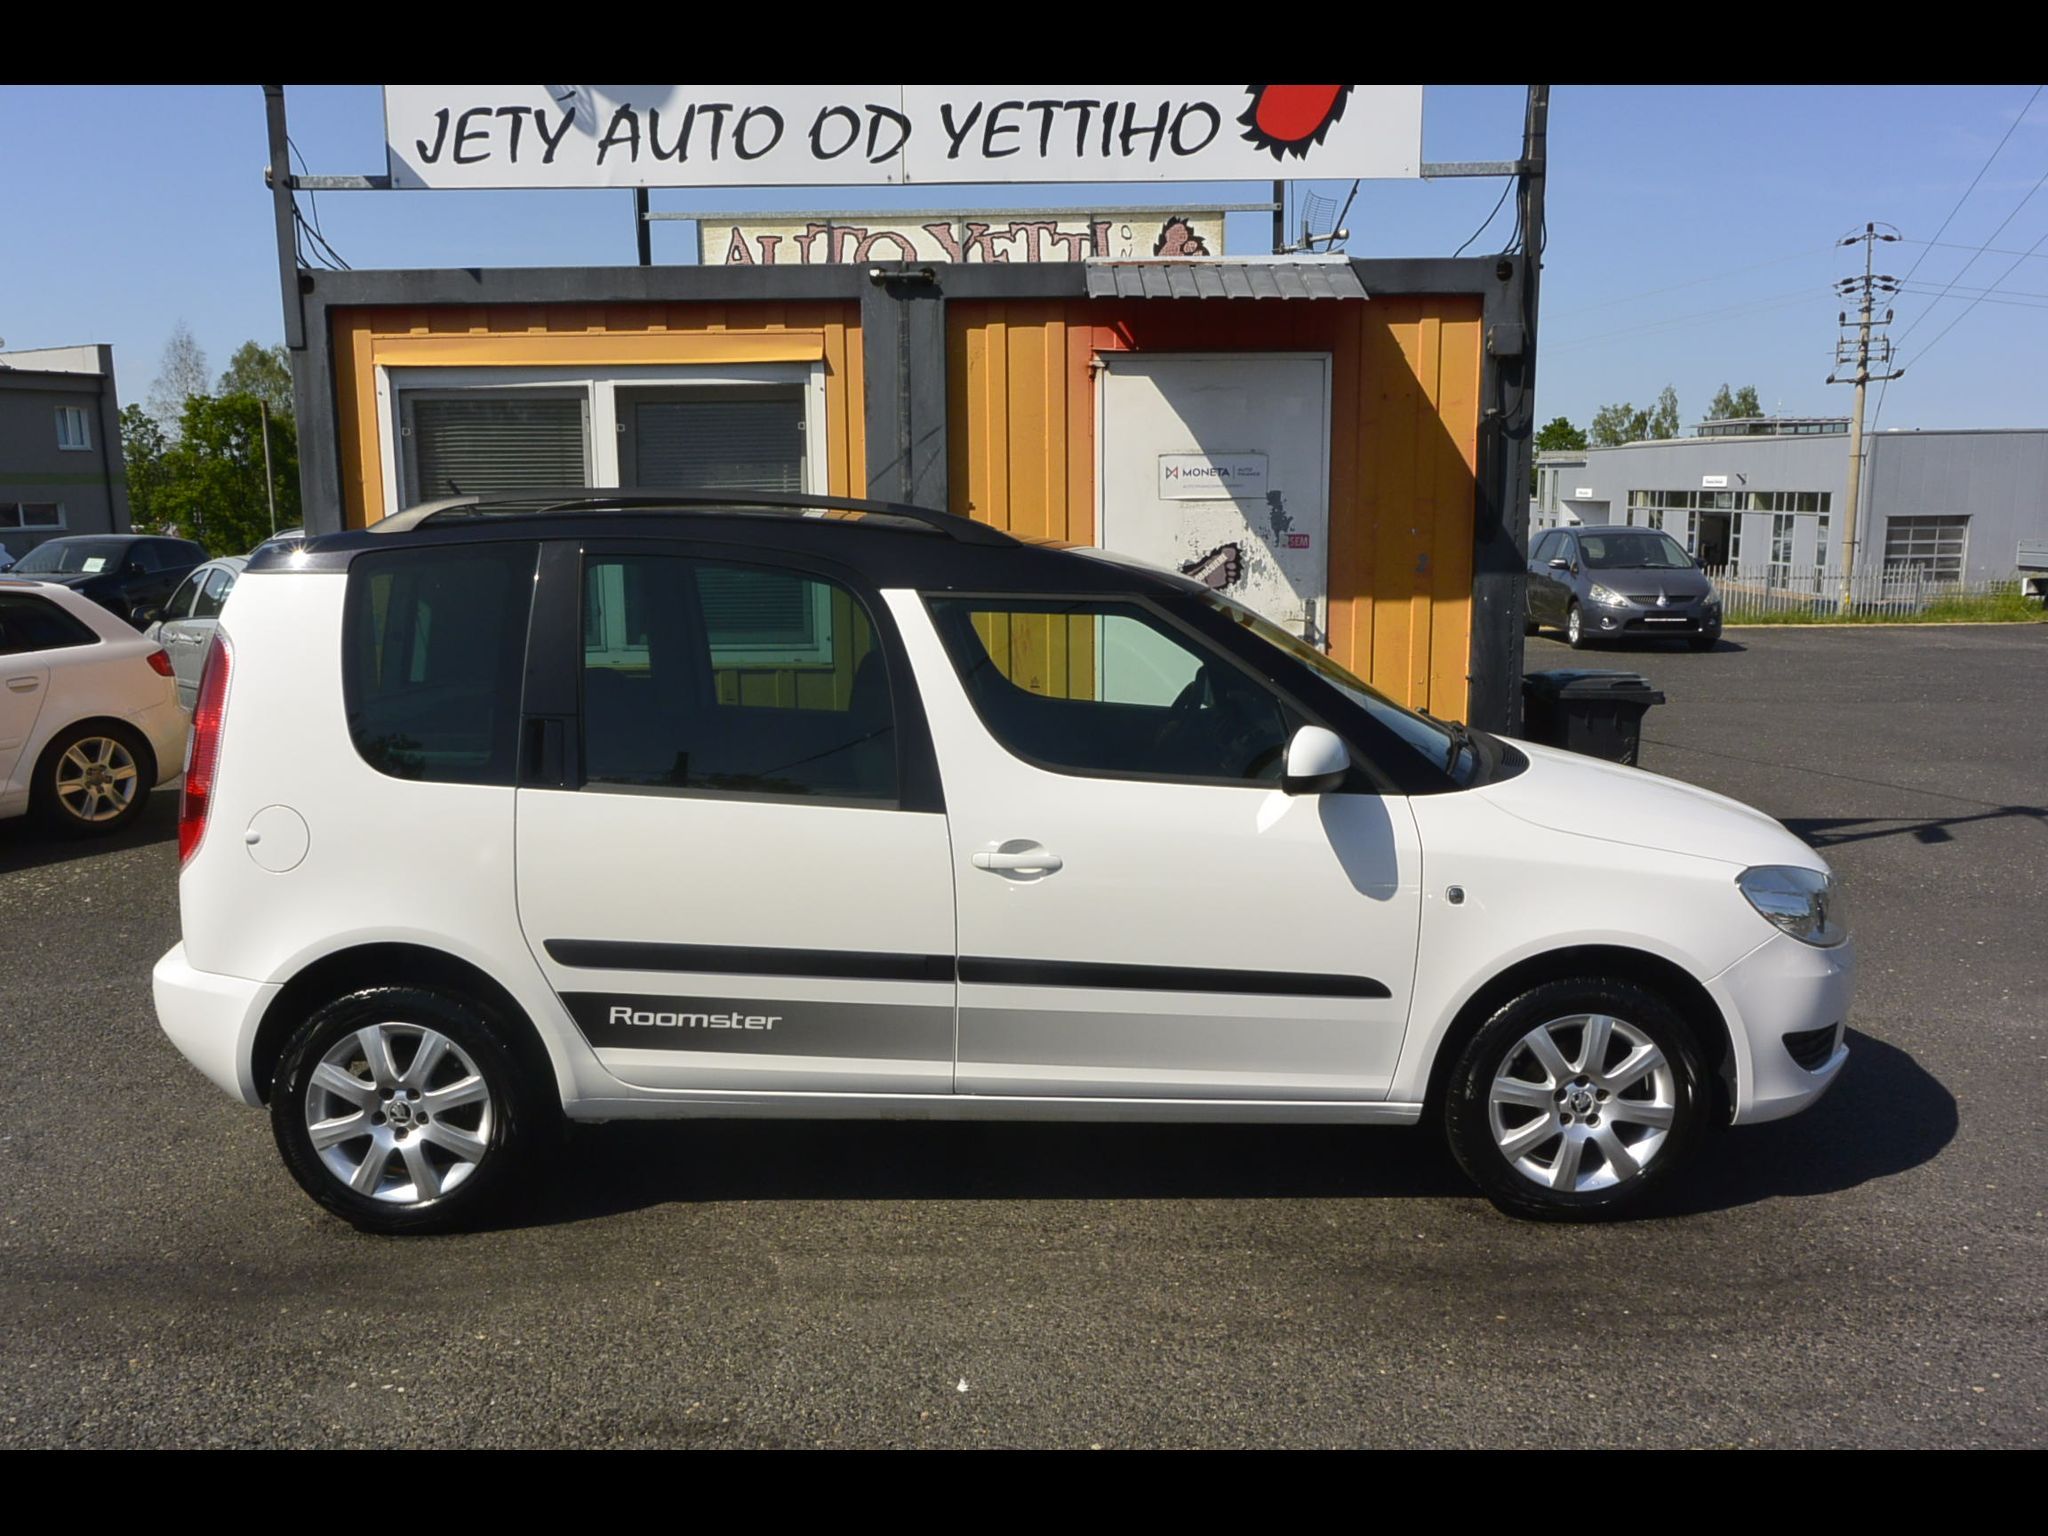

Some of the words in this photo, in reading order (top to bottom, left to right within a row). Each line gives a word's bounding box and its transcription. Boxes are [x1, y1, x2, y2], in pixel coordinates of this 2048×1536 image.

[416, 91, 577, 164] JETÝ
[597, 103, 784, 166] AUTO
[808, 104, 912, 164] OD
[940, 100, 1222, 162] YETTIHO
[1182, 467, 1230, 477] MONETA
[609, 1006, 783, 1030] Roomster
